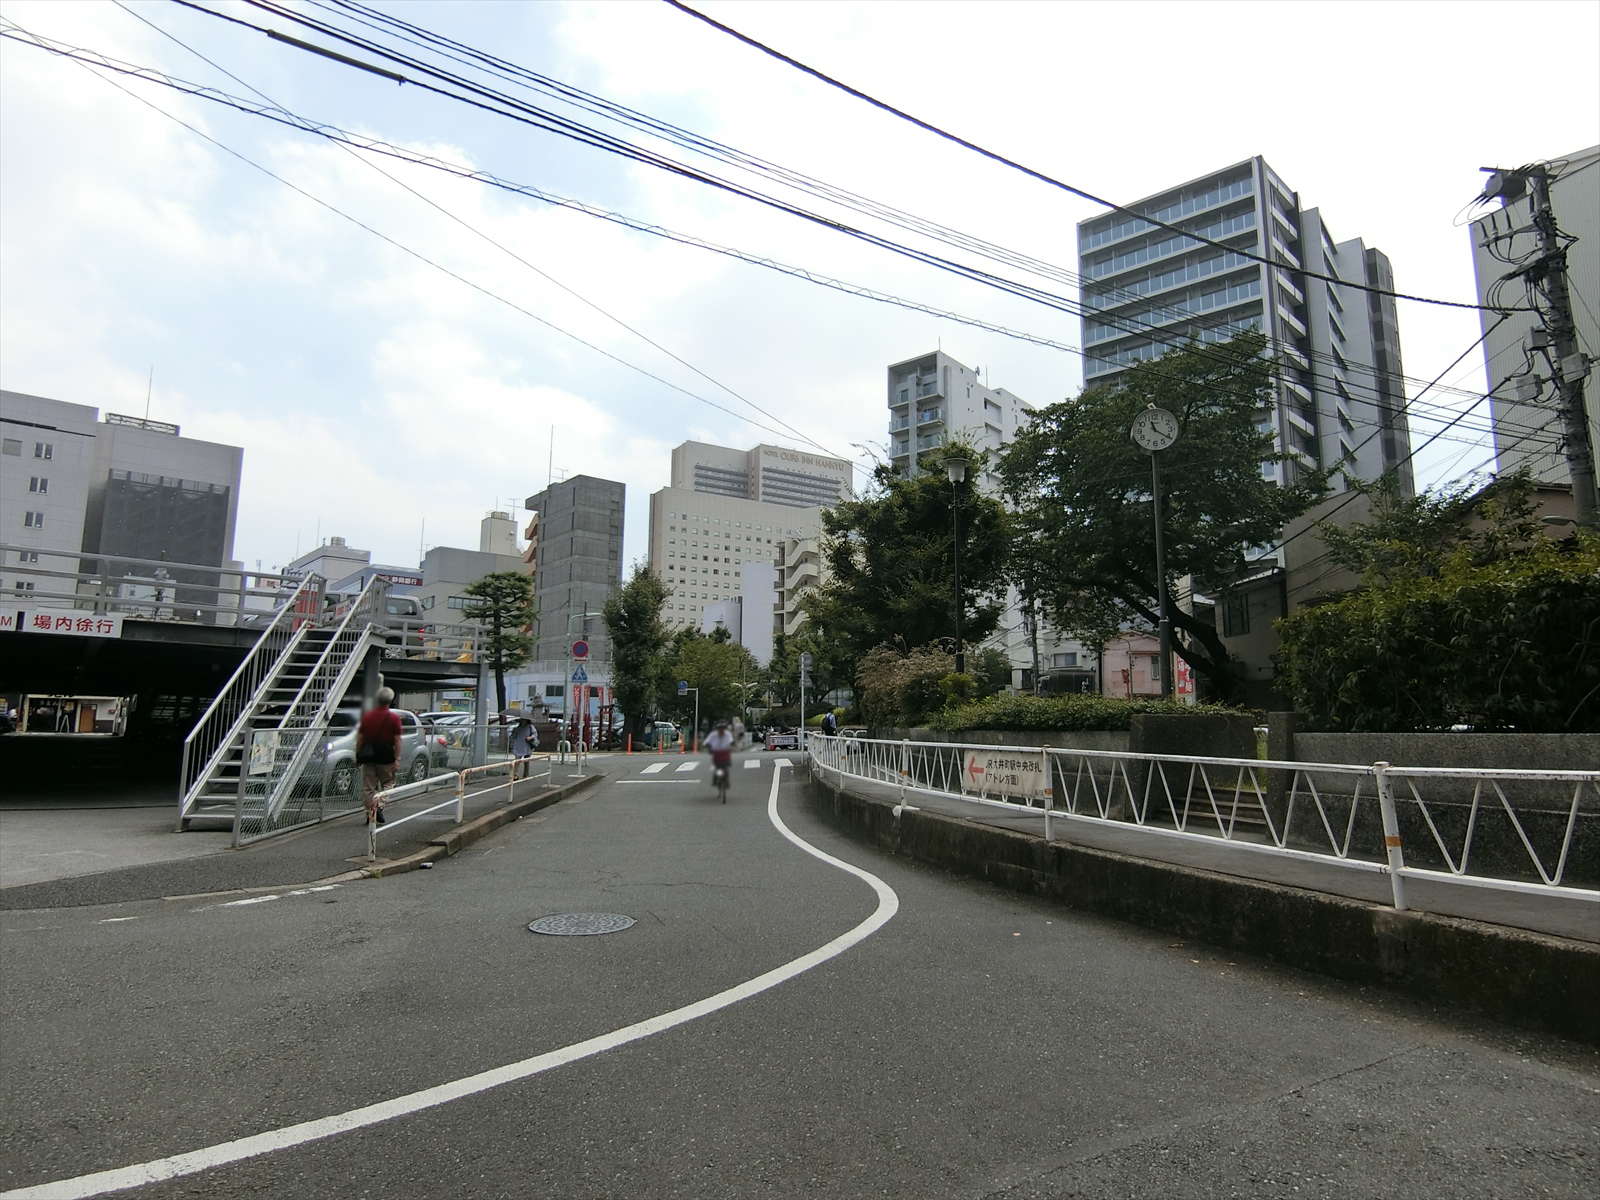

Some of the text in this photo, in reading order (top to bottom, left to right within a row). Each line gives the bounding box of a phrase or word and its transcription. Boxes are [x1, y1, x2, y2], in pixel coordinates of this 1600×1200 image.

[763, 449, 844, 471] HOTEL OURS INN HANKYU
[33, 614, 114, 634] 場内徐行
[985, 759, 1042, 772] JR大井町駅中央改札
[985, 772, 1019, 786] (アトレ方面)
